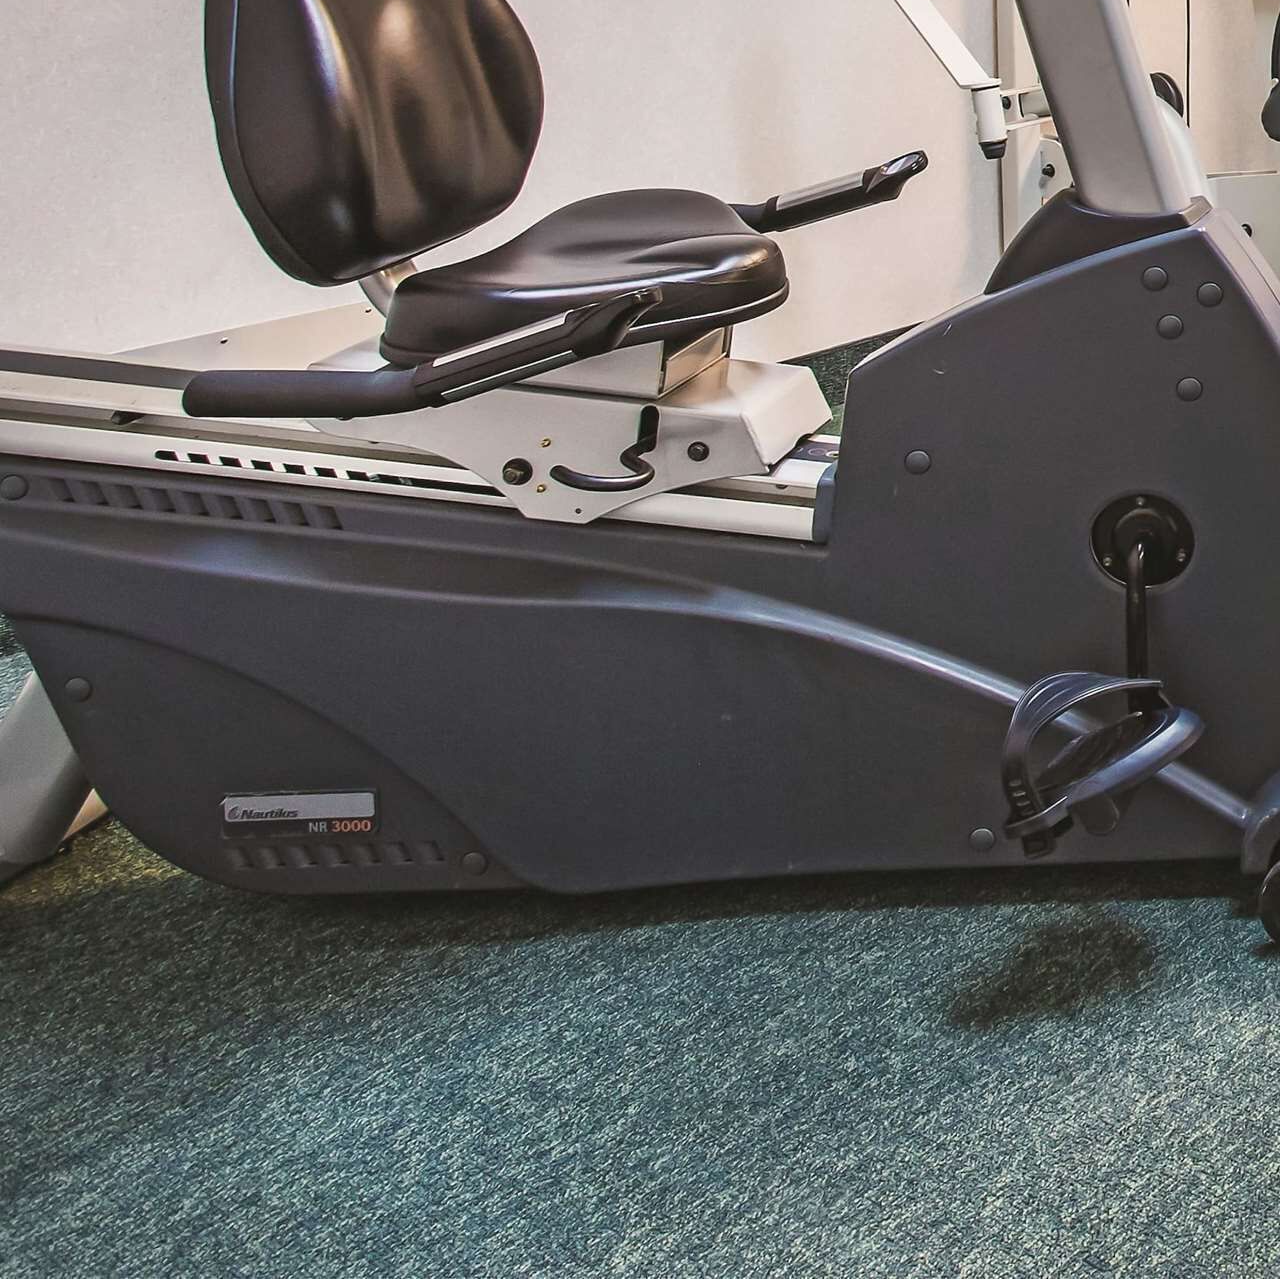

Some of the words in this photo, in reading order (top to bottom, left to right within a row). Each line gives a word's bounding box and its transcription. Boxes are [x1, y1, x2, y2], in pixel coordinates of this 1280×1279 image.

[240, 806, 299, 820] Nautilus
[308, 822, 328, 833] NR
[331, 820, 372, 833] 3000
